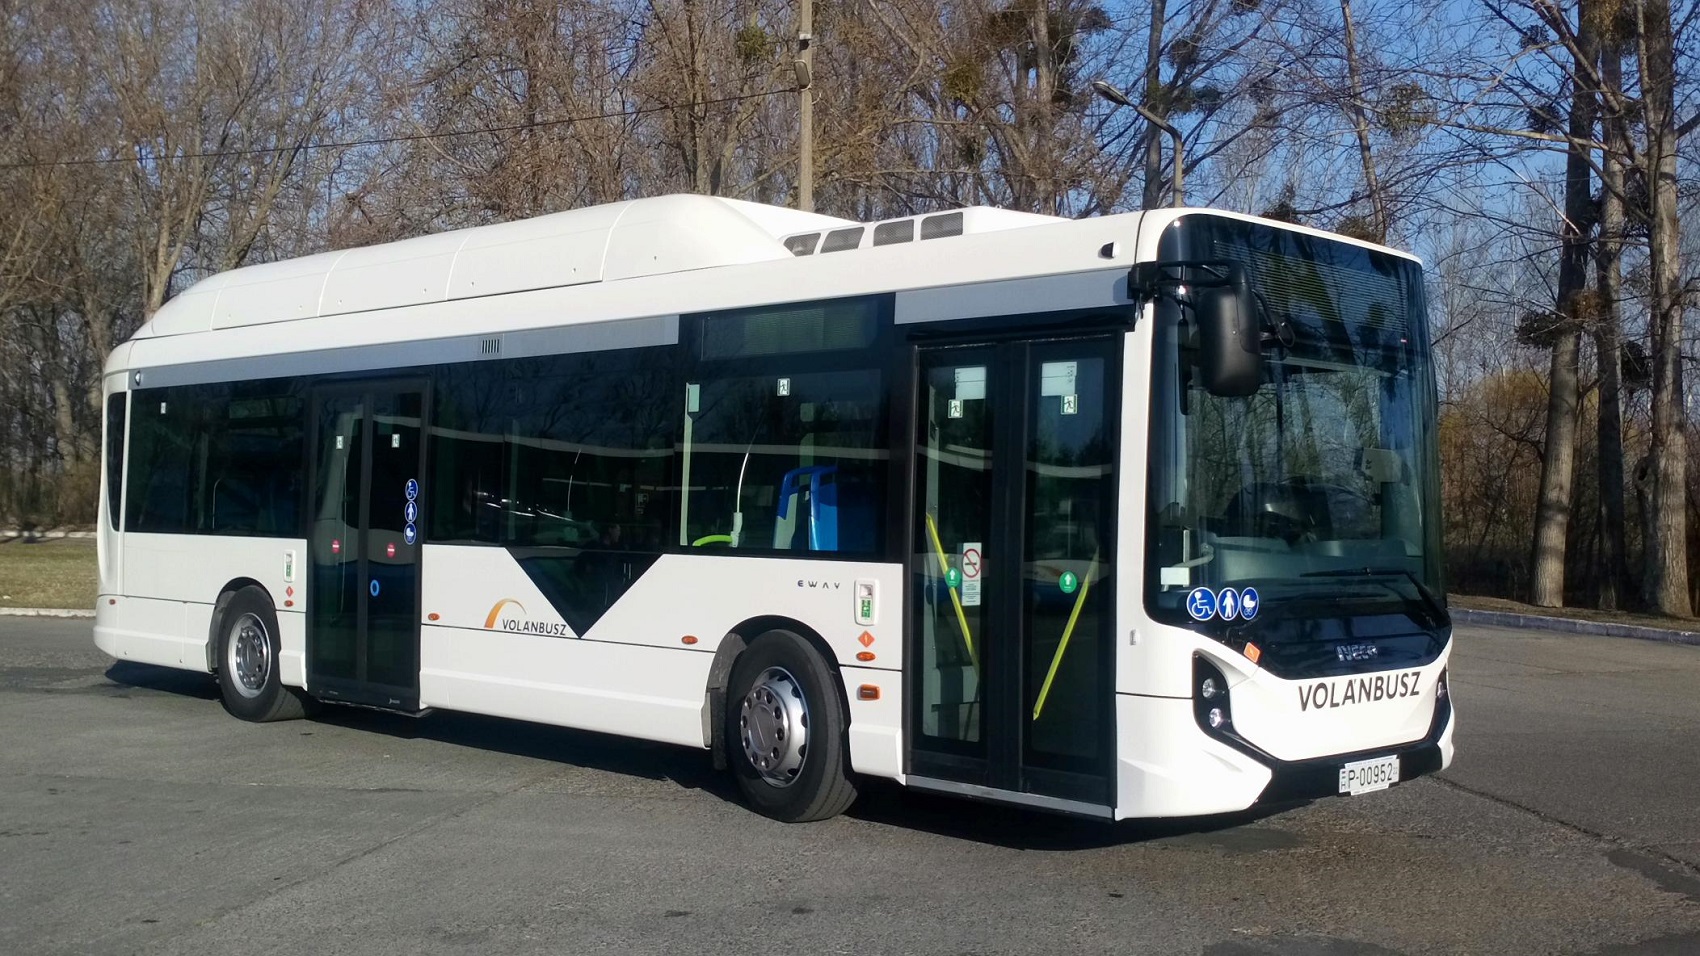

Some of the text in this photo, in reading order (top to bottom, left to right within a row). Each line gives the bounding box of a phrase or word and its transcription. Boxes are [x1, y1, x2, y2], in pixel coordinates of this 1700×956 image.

[502, 619, 566, 636] VOLÁNBUSZ
[1298, 671, 1421, 711] VOLÁNBUSZ
[1348, 762, 1393, 788] P-00952
